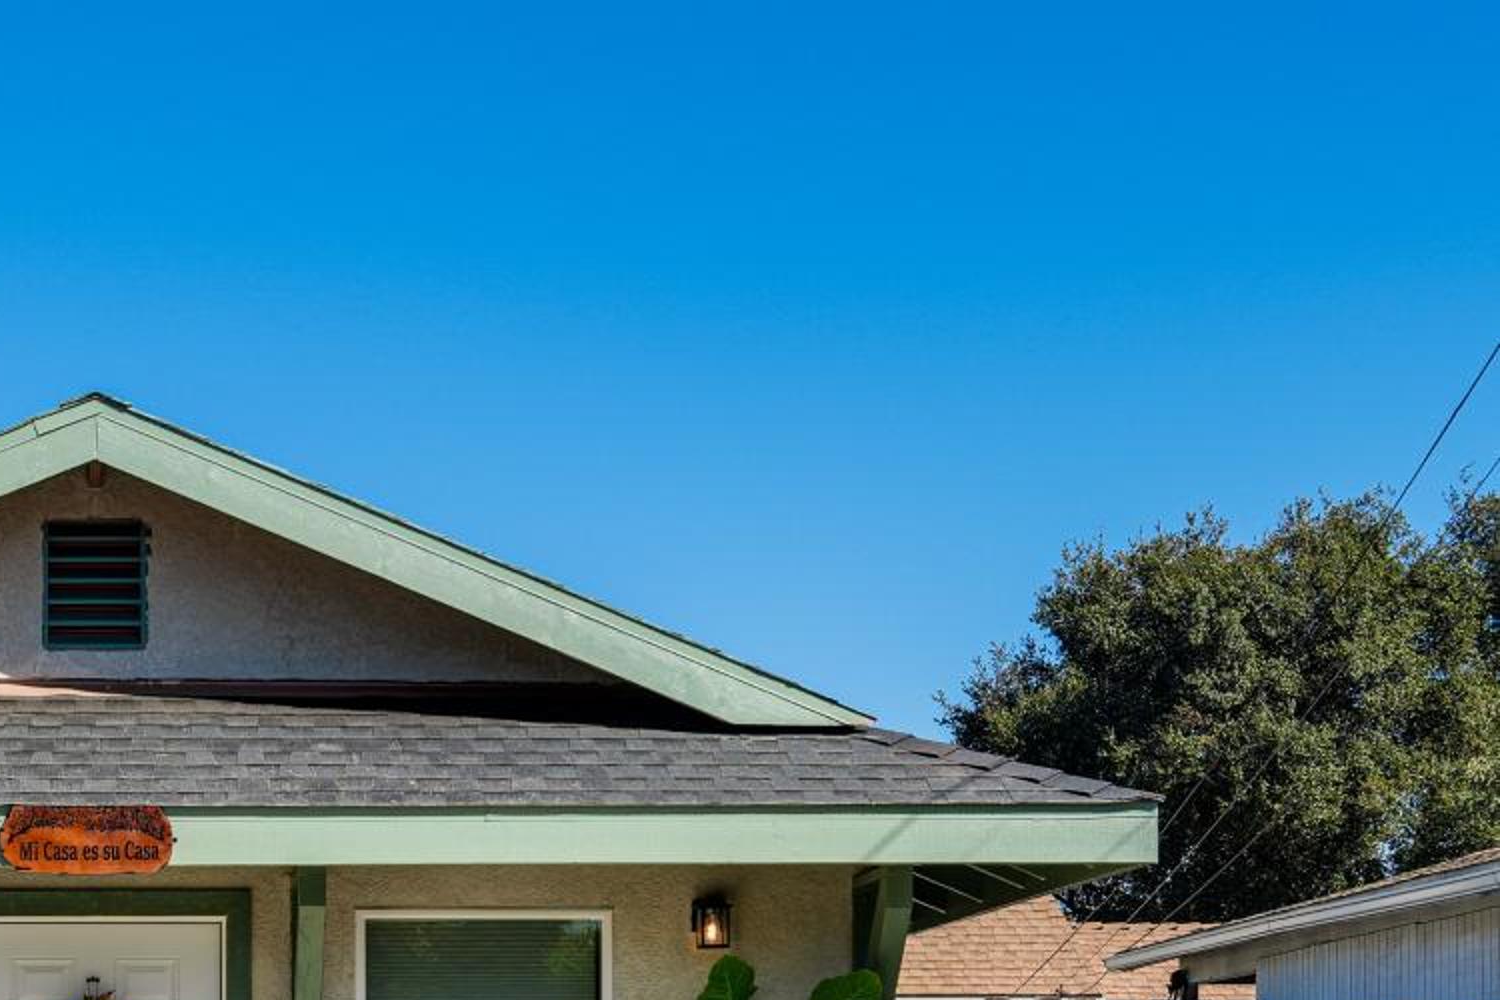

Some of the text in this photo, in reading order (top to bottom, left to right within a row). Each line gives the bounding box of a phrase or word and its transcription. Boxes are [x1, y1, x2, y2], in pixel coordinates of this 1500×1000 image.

[19, 840, 160, 861] Mi Casa es su Casa
